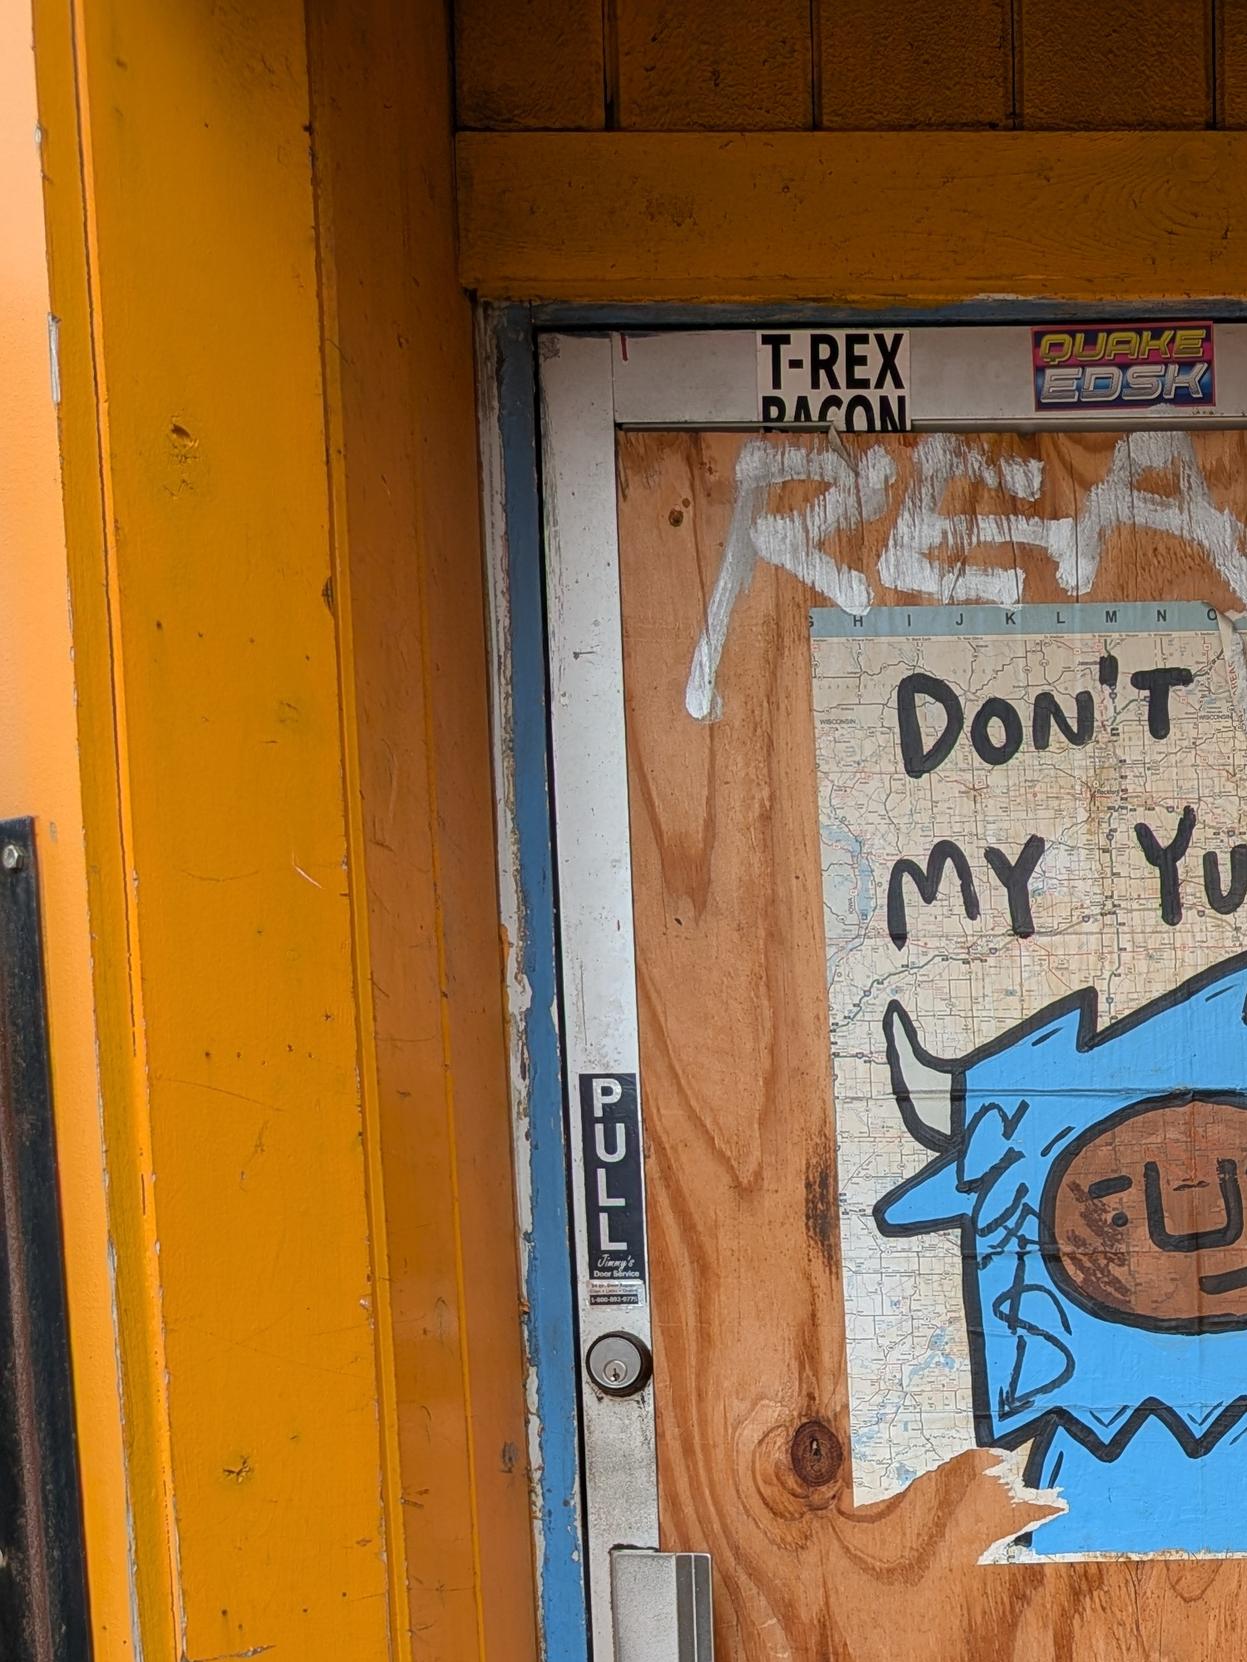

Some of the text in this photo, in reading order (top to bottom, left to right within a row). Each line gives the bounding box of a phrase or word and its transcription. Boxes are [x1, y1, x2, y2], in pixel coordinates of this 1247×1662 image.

[761, 333, 905, 390] T-REX
[1039, 329, 1206, 364] QUAKE
[1040, 362, 1208, 403] EDSK
[852, 615, 863, 627] H
[955, 612, 964, 626] J
[1005, 611, 1016, 625] K
[1056, 611, 1066, 624] L
[1105, 610, 1118, 623] M
[1156, 609, 1167, 621] N
[898, 655, 1194, 779] DON'T
[887, 834, 1046, 950] MY
[592, 1077, 628, 1250] PULL
[597, 1254, 635, 1272] Jimmy's
[613, 1270, 640, 1278] Service
